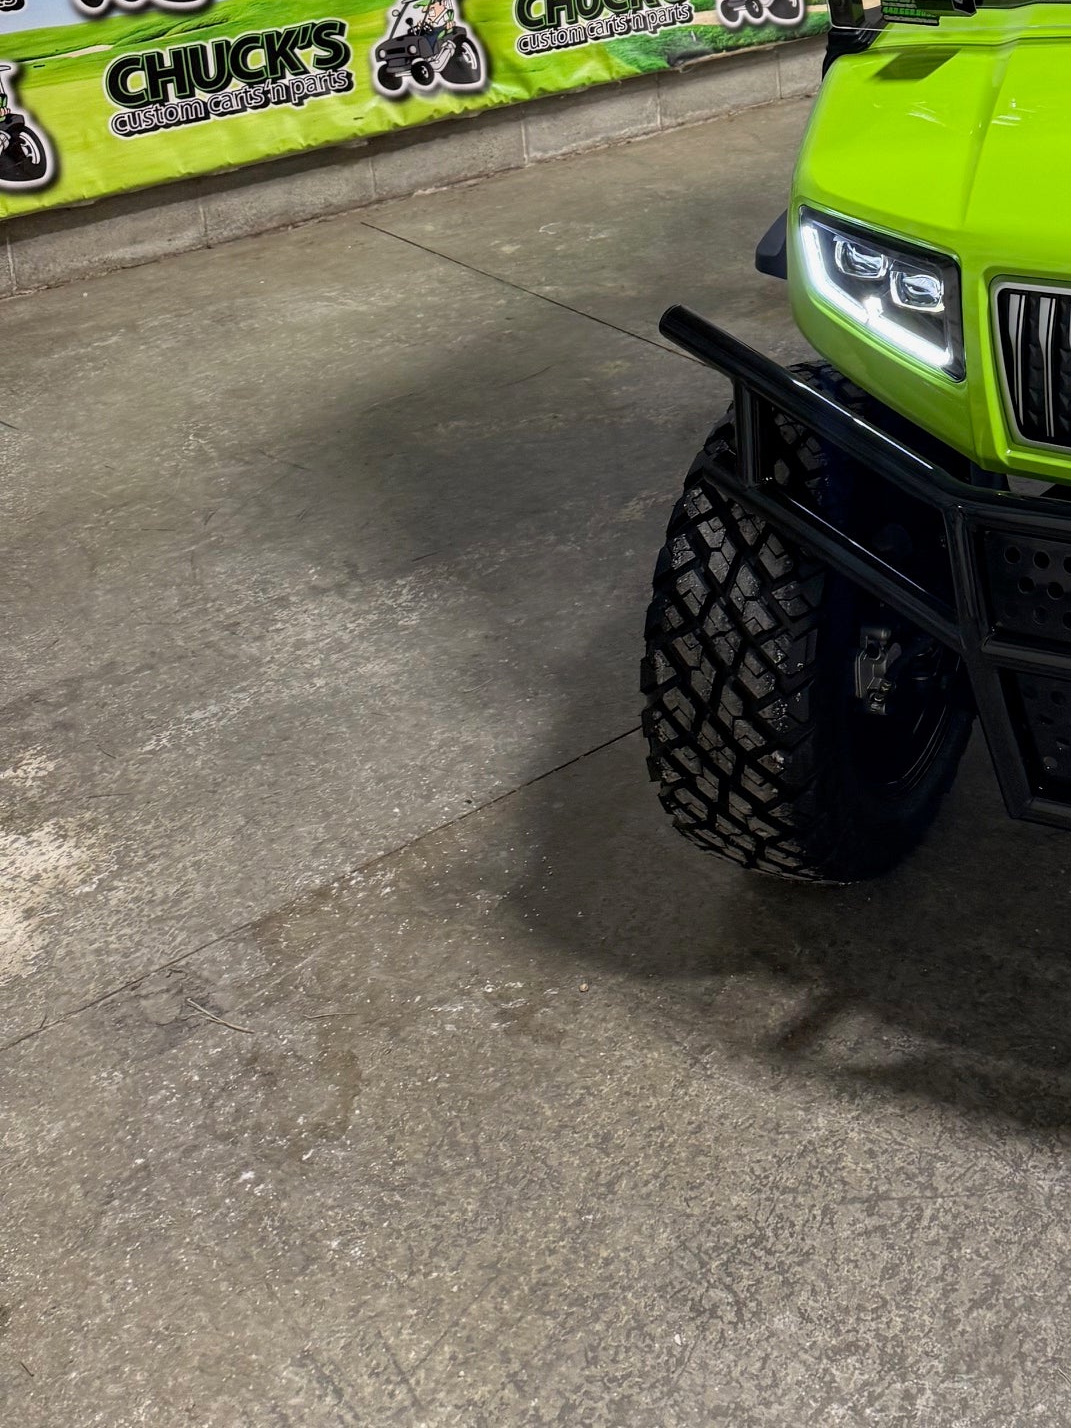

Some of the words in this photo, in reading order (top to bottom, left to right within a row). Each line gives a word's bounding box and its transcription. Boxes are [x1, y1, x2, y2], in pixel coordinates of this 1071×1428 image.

[517, 23, 586, 53] custom
[645, 4, 690, 32] parts
[106, 20, 351, 109] CHUCK'S
[111, 101, 205, 136] custom
[289, 70, 348, 104] parts
